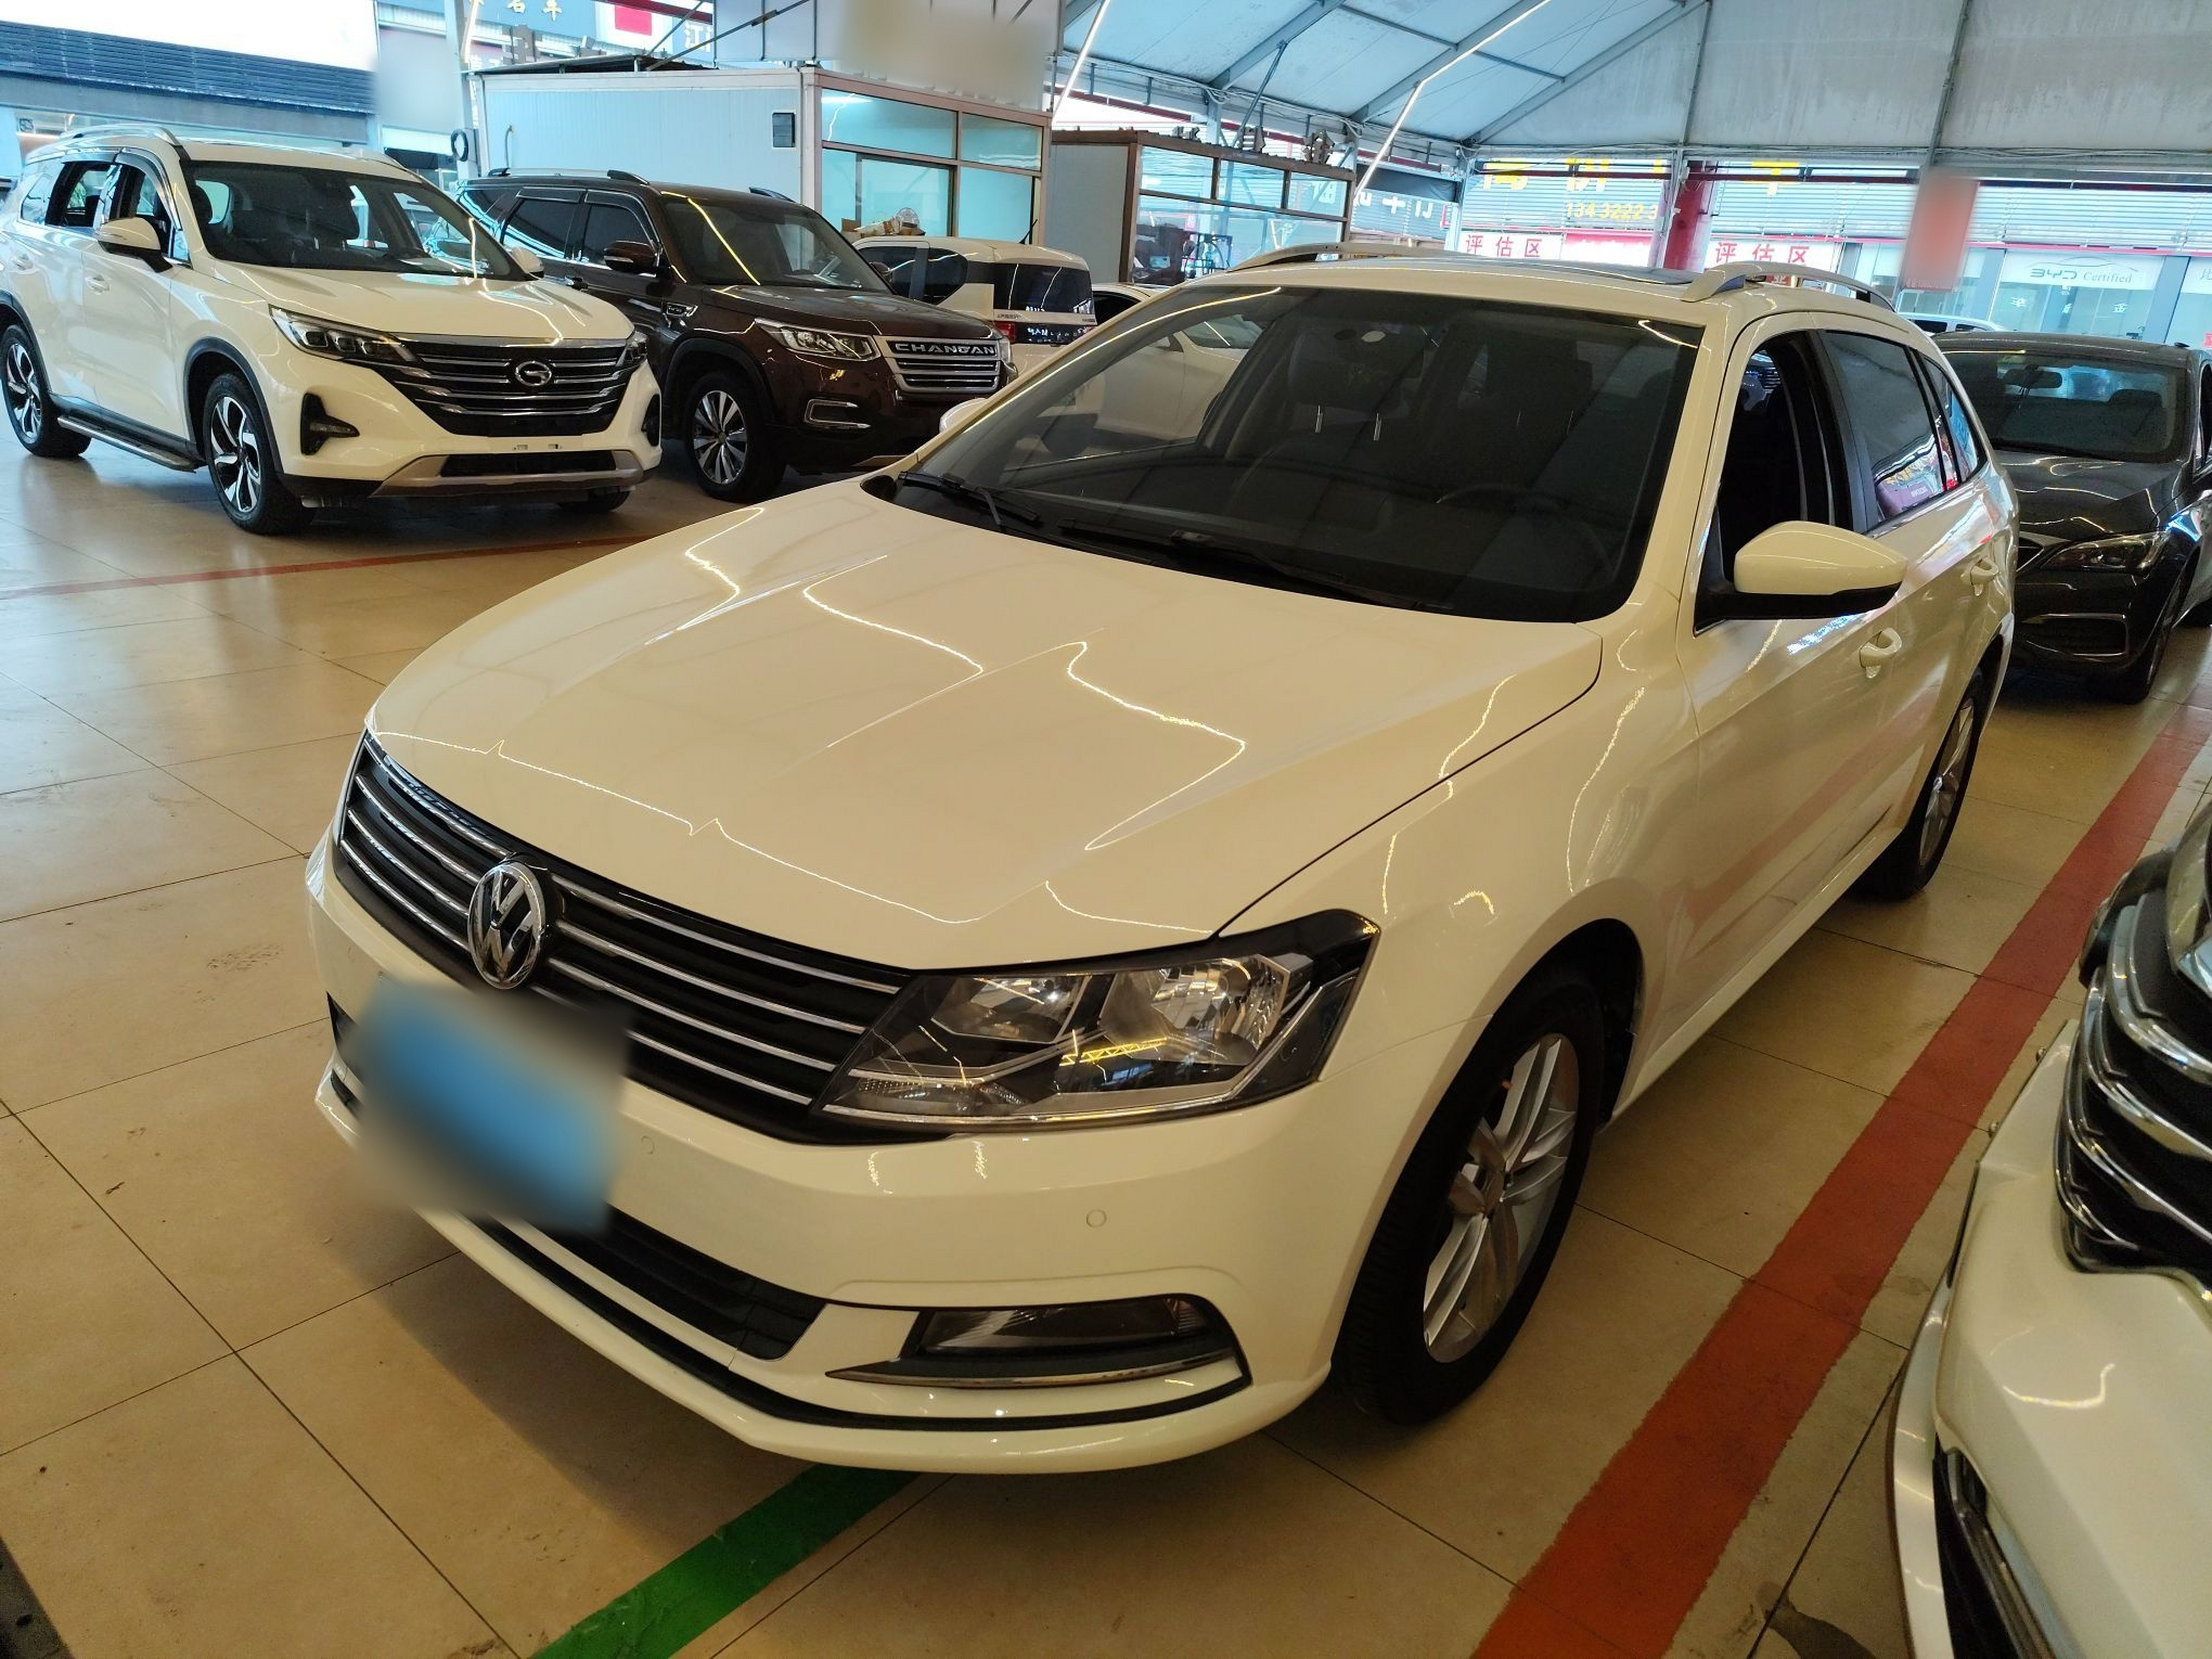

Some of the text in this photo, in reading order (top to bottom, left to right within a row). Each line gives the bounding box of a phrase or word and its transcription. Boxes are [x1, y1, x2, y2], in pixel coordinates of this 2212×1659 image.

[1466, 234, 1542, 257] 评估区
[1715, 242, 1809, 263] 评估区
[2030, 268, 2133, 284] BYD Certified
[895, 343, 995, 354] CHANGAN
